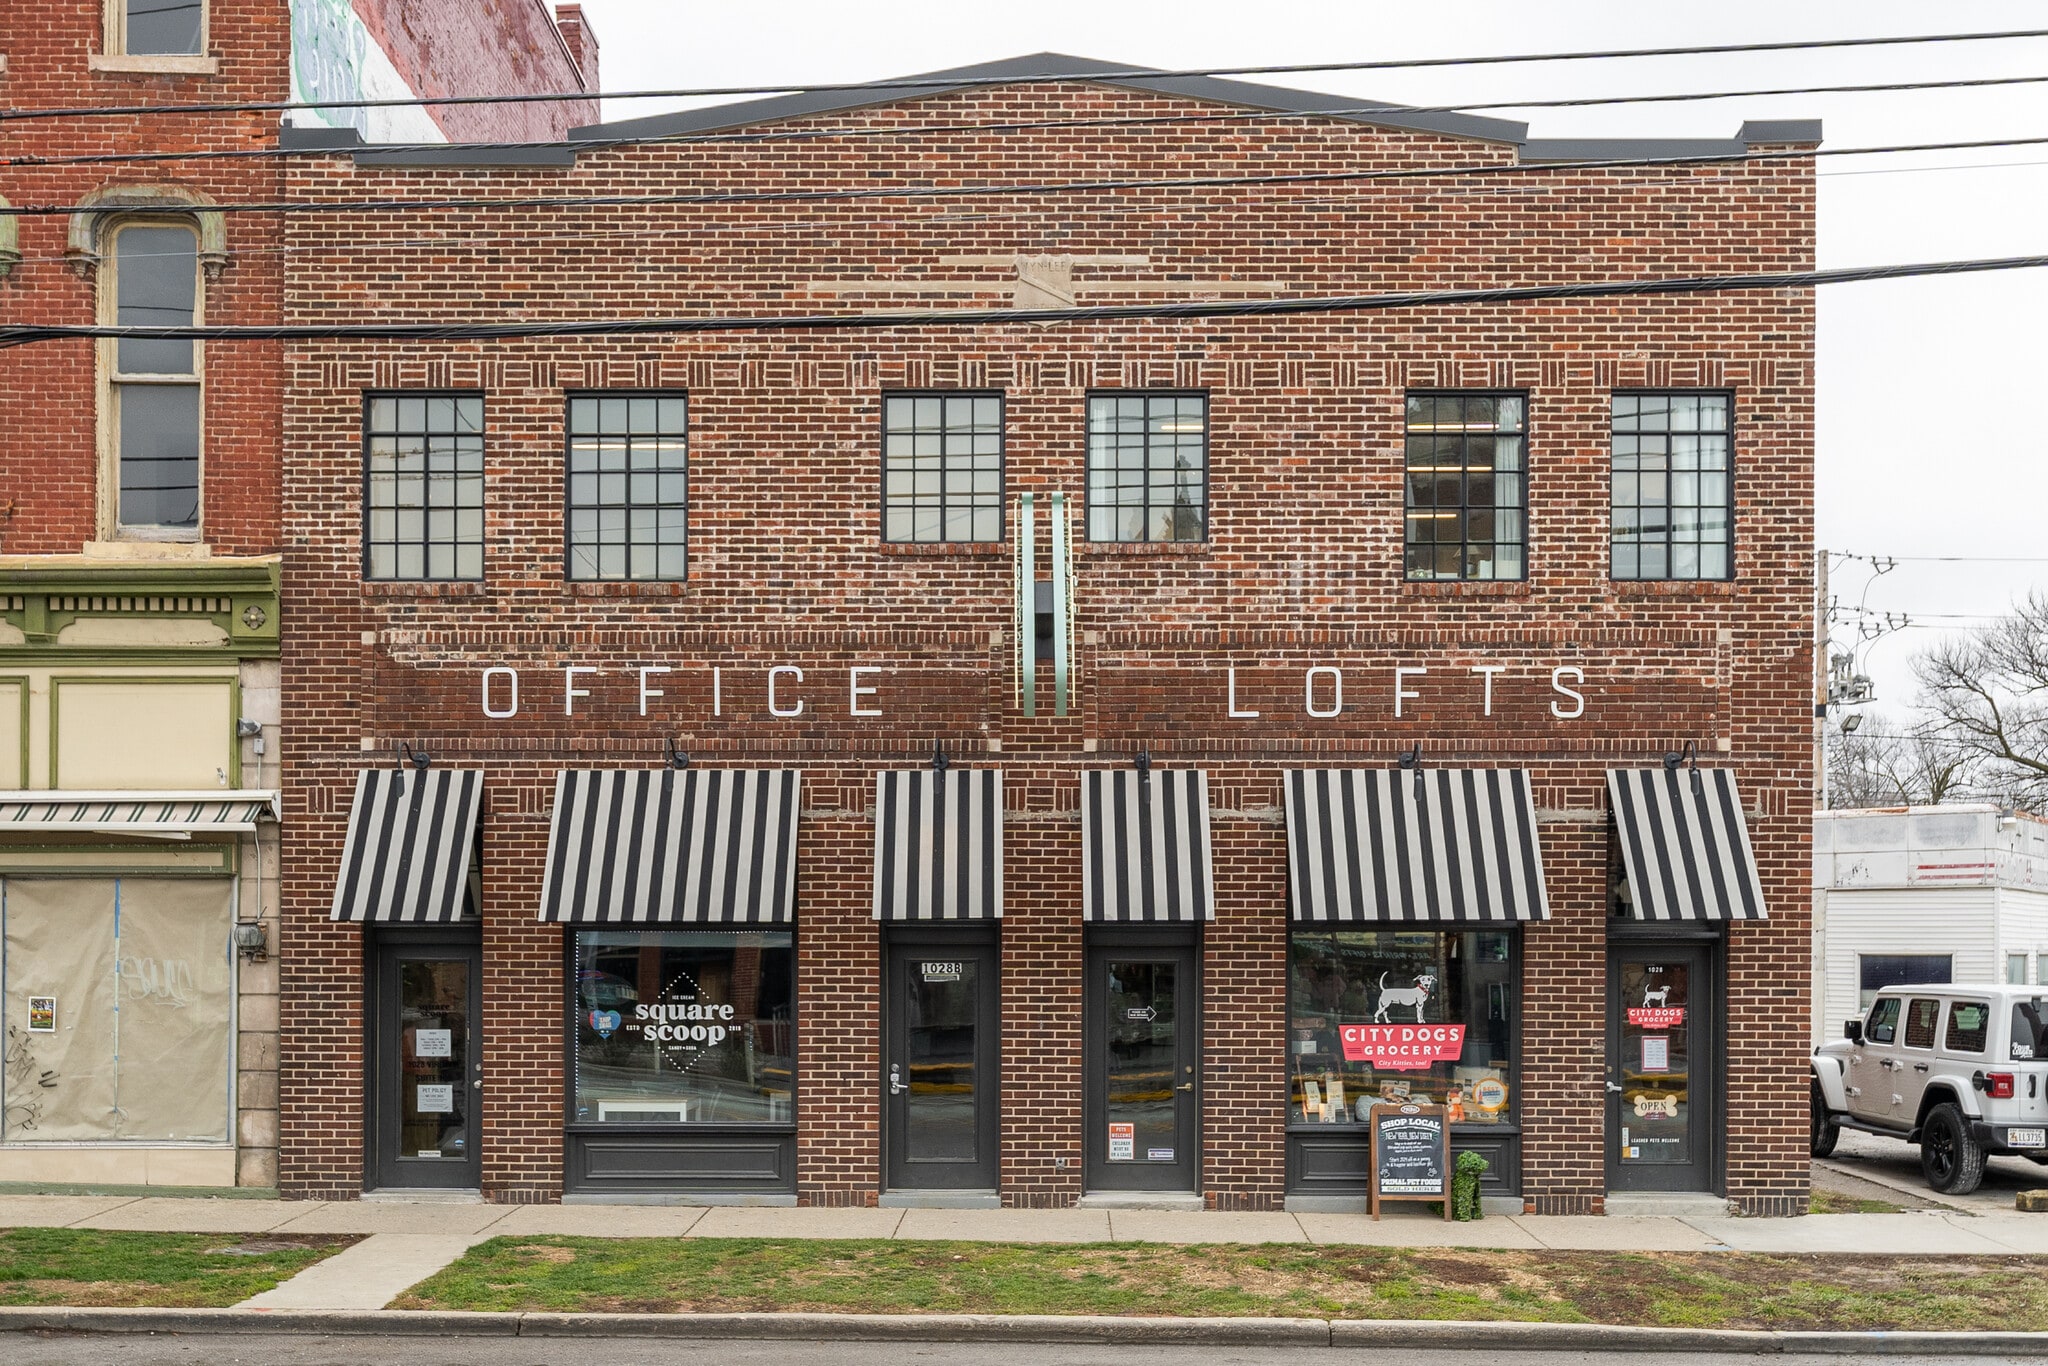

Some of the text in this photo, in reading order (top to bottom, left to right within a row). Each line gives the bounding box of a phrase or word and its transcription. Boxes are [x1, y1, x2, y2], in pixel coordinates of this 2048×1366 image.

[482, 665, 1585, 718] OFFICE LOFTS
[924, 963, 961, 973] 1028B
[635, 1003, 734, 1025] square
[644, 1024, 726, 1047] scoop
[1344, 1028, 1459, 1042] CITY DOGS
[1364, 1045, 1442, 1055] GROCERY
[1640, 1101, 1667, 1111] OPEN
[1380, 1118, 1441, 1130] SHOP LOCAL
